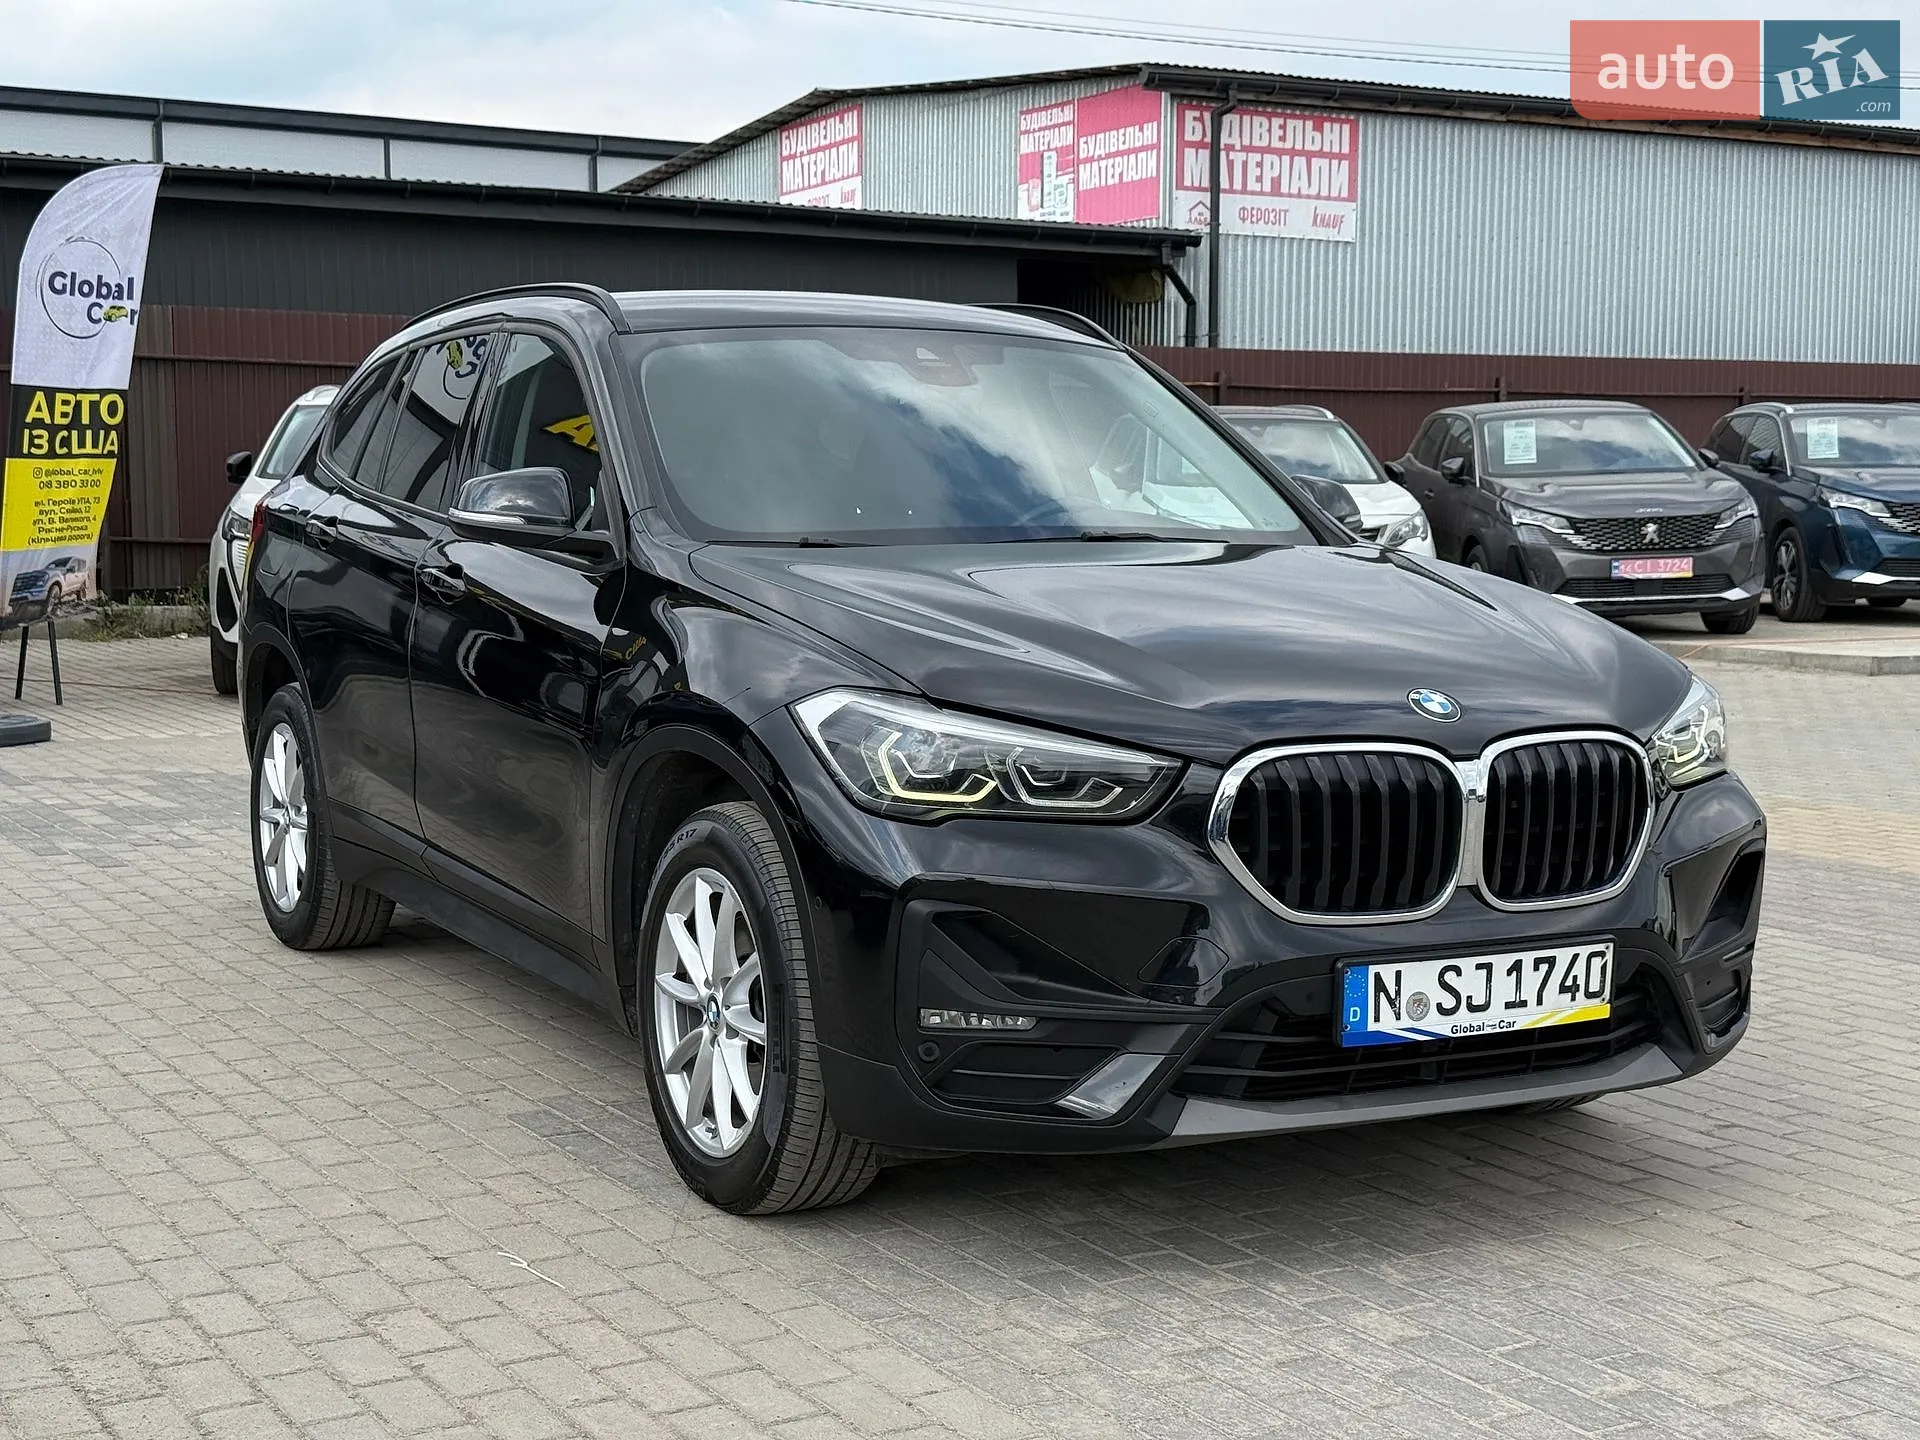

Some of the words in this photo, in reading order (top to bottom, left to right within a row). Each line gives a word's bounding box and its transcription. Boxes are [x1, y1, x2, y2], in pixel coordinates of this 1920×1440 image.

[1020, 104, 1074, 131] БУДІВЕЛЬНІ
[782, 110, 858, 157] БУДІВЕЛЬНІ
[1020, 125, 1074, 154] МАТЕРІАЛИ
[1079, 121, 1158, 159] БУДІВЕЛЬНІ
[782, 140, 858, 194] МАТЕРІАЛИ
[1079, 149, 1157, 191] МАТЕРІАЛИ
[1238, 206, 1289, 226] ФЕРОЗІТ
[48, 270, 135, 301] Global
[86, 302, 138, 325] Cr
[24, 391, 125, 425] АВТО
[55, 429, 118, 455] США
[1349, 1007, 1360, 1022] D
[1450, 1020, 1485, 1035] Global
[1498, 1019, 1517, 1030] Car
